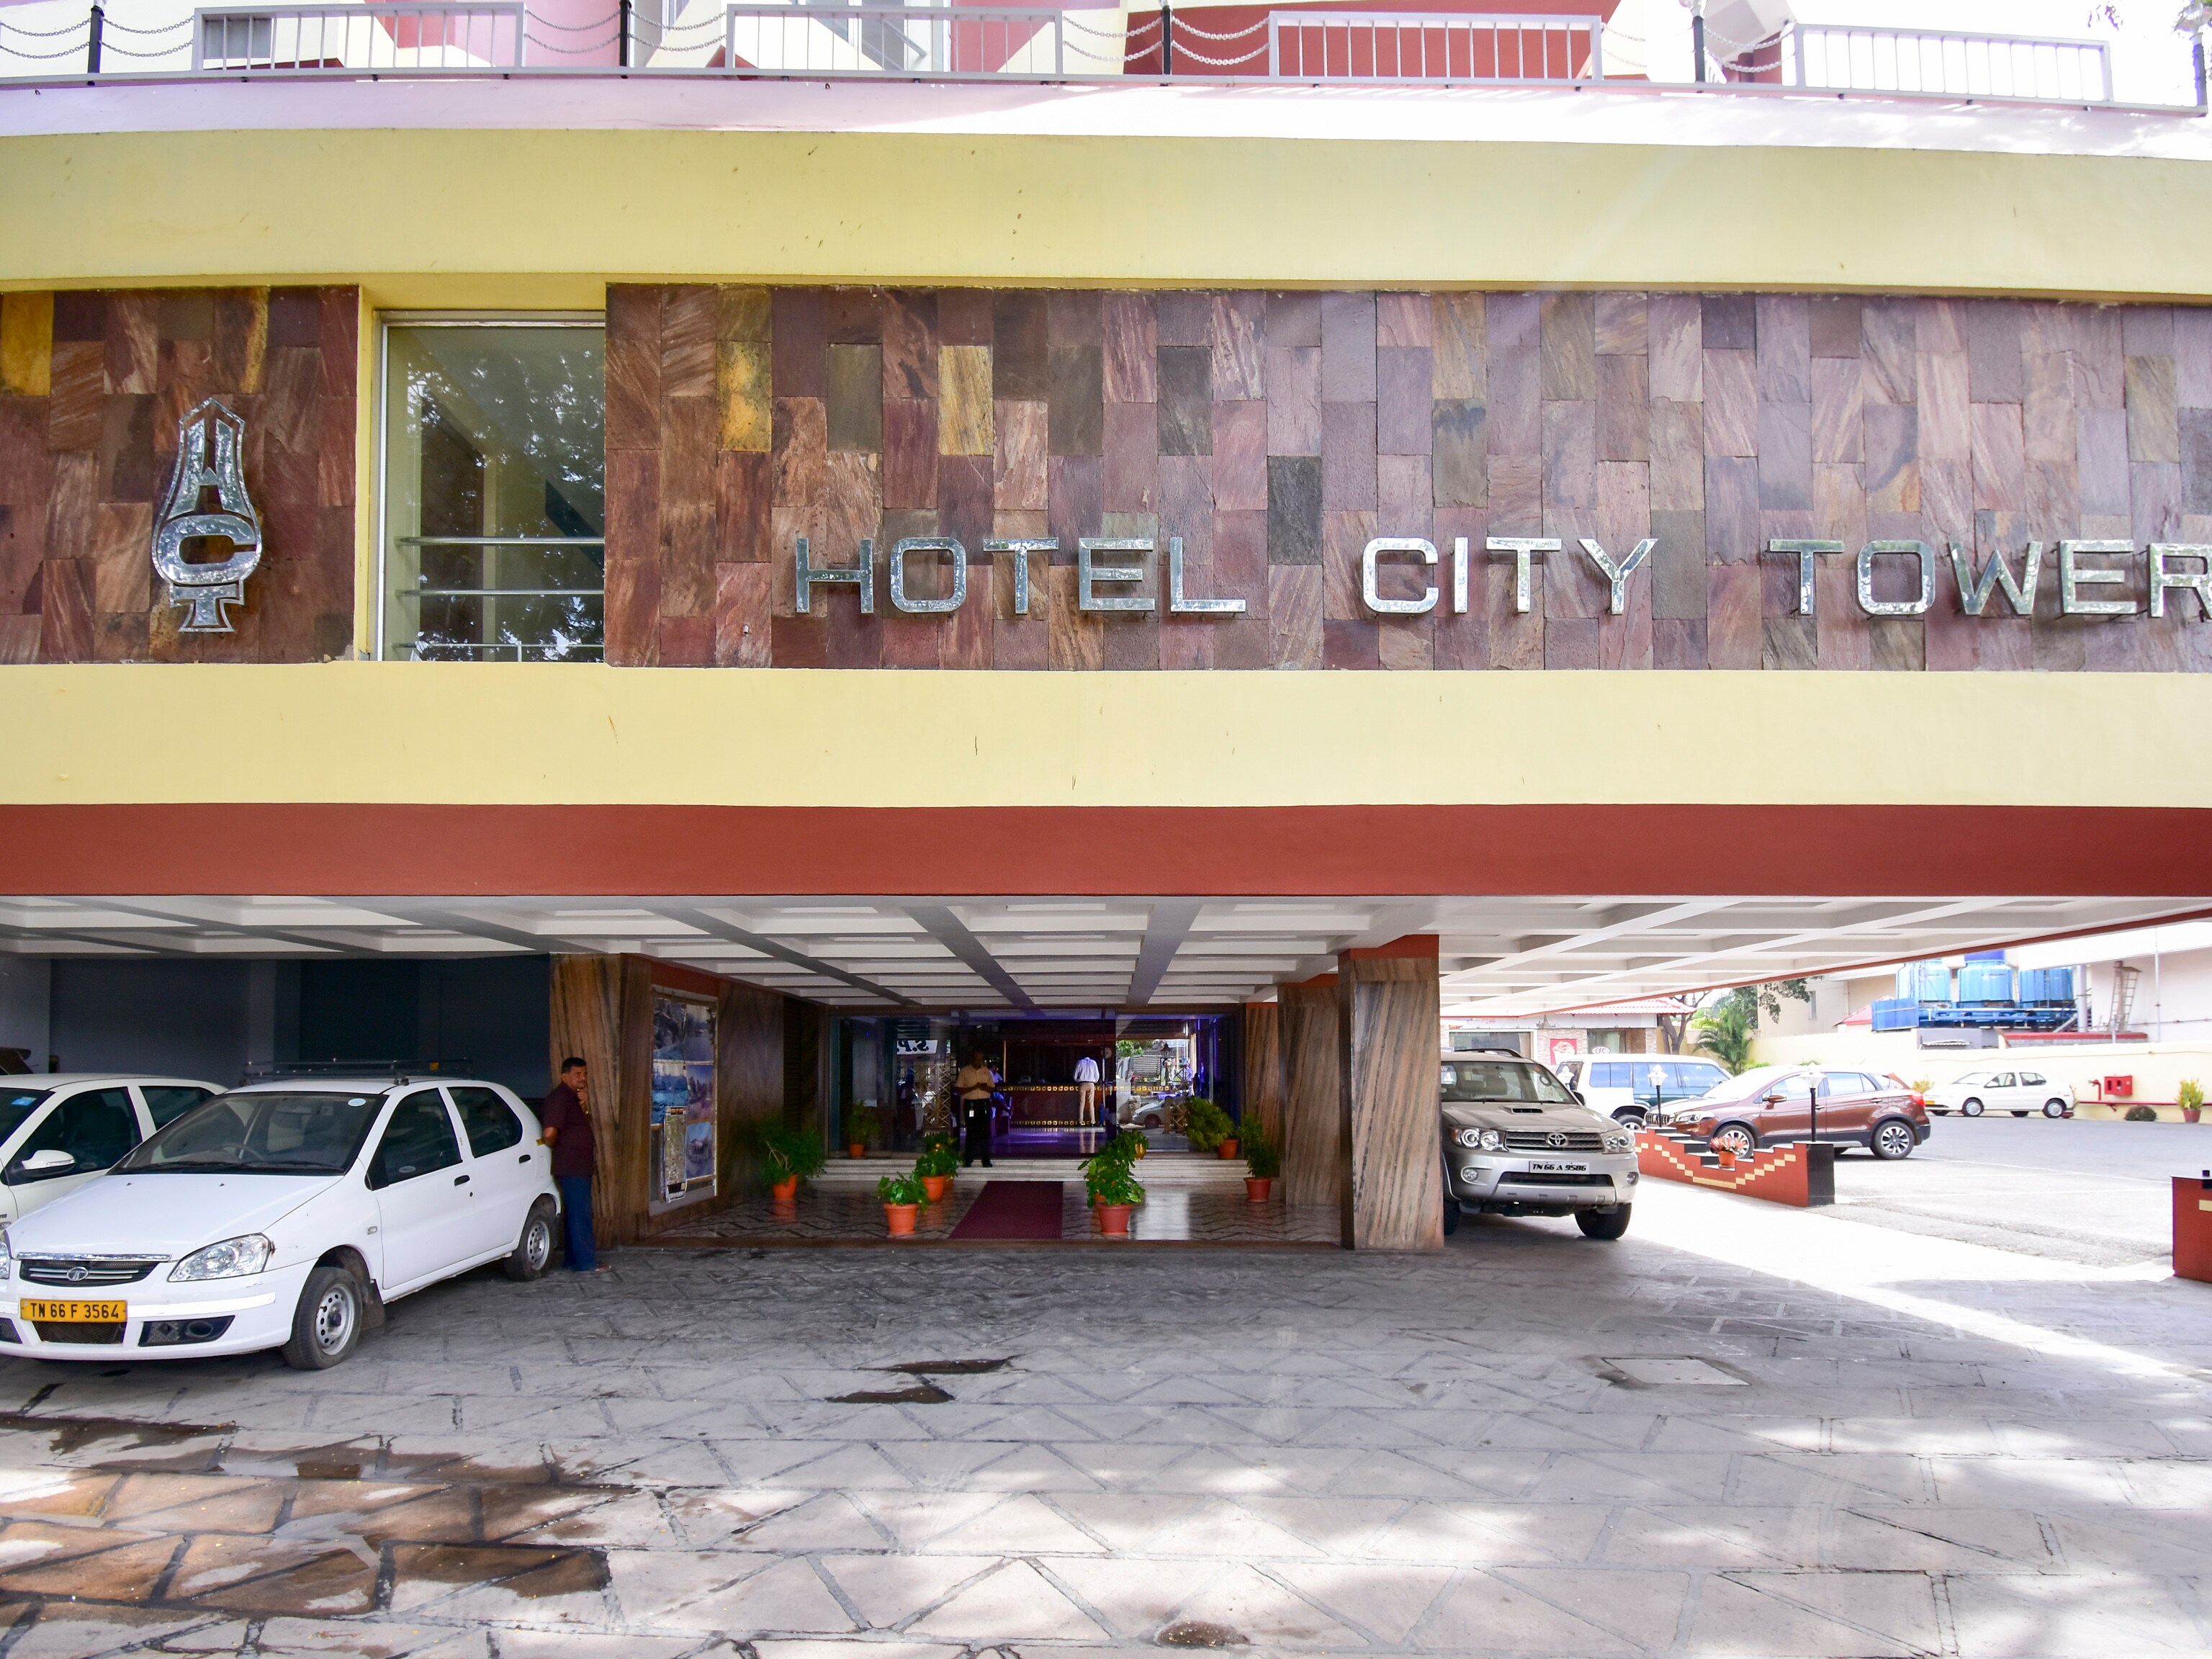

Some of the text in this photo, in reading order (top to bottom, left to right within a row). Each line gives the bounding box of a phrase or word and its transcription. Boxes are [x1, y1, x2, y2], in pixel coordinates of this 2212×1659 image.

[796, 536, 2212, 619] HOTEL CITY TOWER
[31, 1303, 119, 1318] TN 66 F 3564
